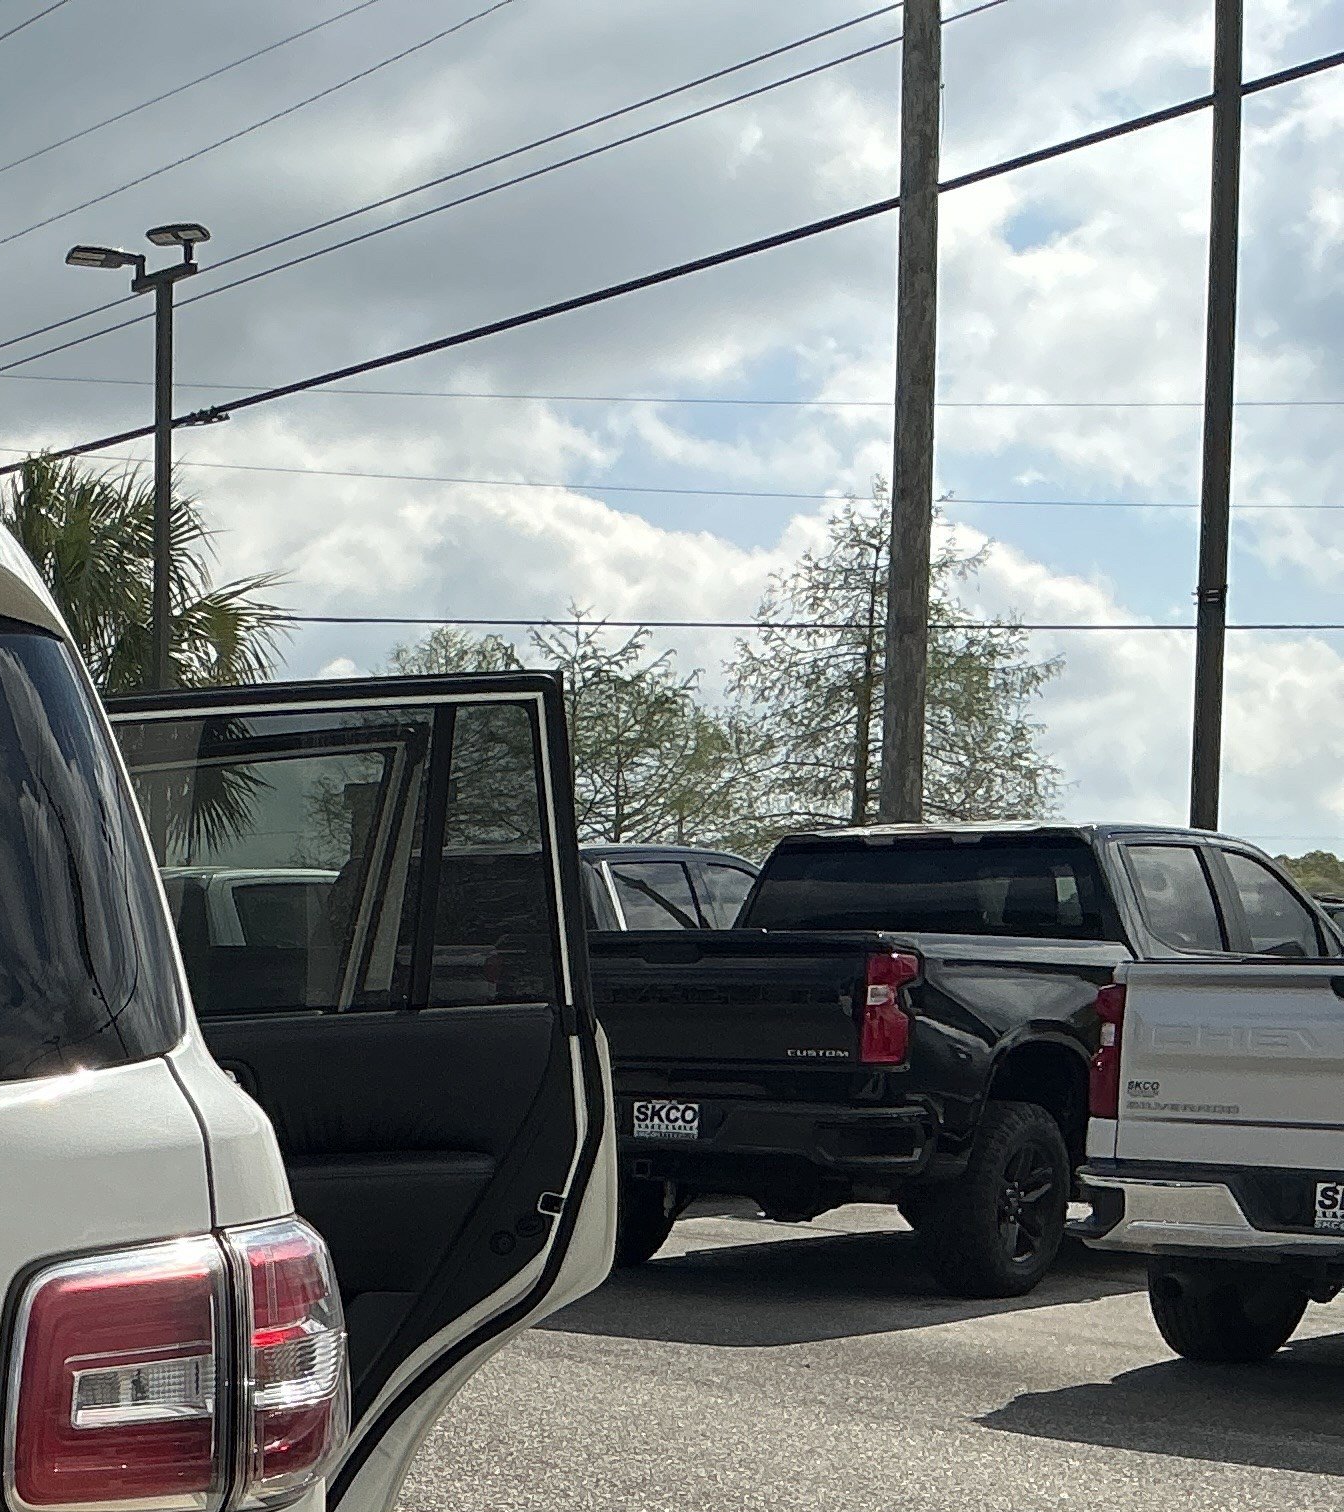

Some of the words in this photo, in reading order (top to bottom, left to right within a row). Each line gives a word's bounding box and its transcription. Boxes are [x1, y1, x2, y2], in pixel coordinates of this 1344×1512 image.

[786, 1049, 850, 1058] CUSTOM
[1127, 1081, 1160, 1091] SKCO
[634, 1104, 698, 1124] SKCO
